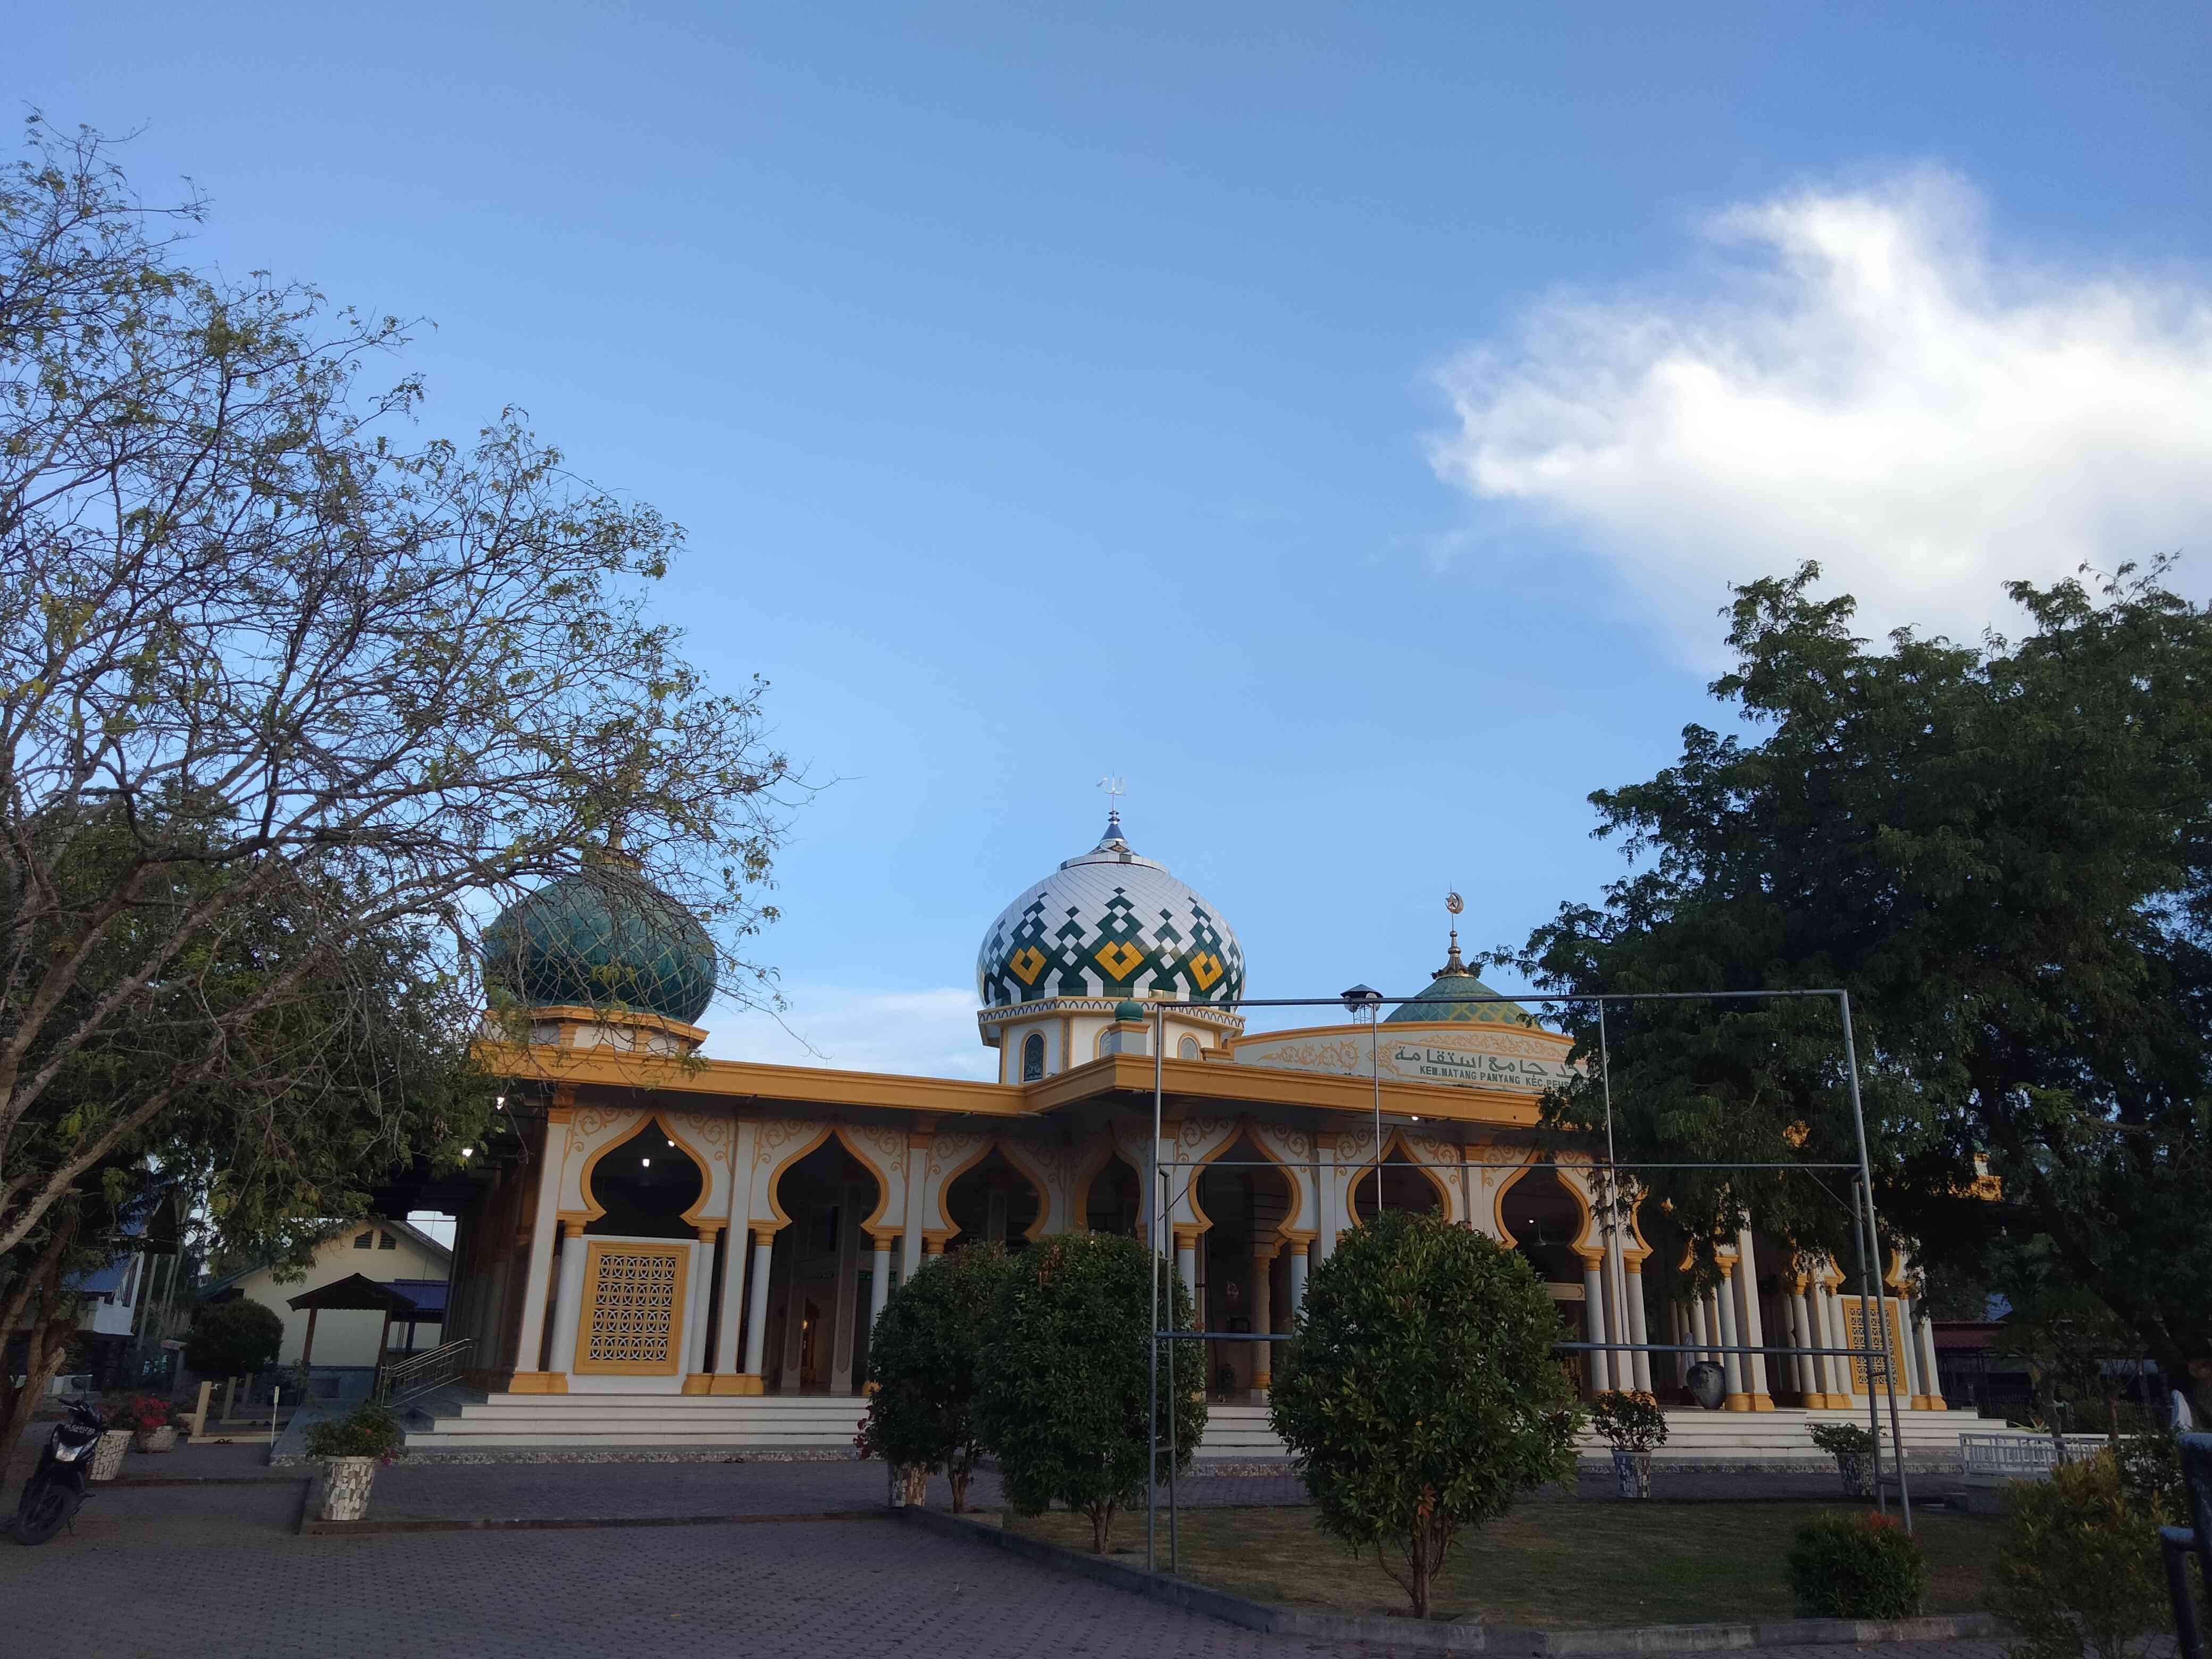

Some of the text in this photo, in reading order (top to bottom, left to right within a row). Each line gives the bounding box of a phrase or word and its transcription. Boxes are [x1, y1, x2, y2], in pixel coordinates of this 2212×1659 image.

[1395, 1045, 1482, 1068] استقامة
[1488, 1057, 1549, 1077] جامع
[1480, 1072, 1520, 1085] PANYANG
